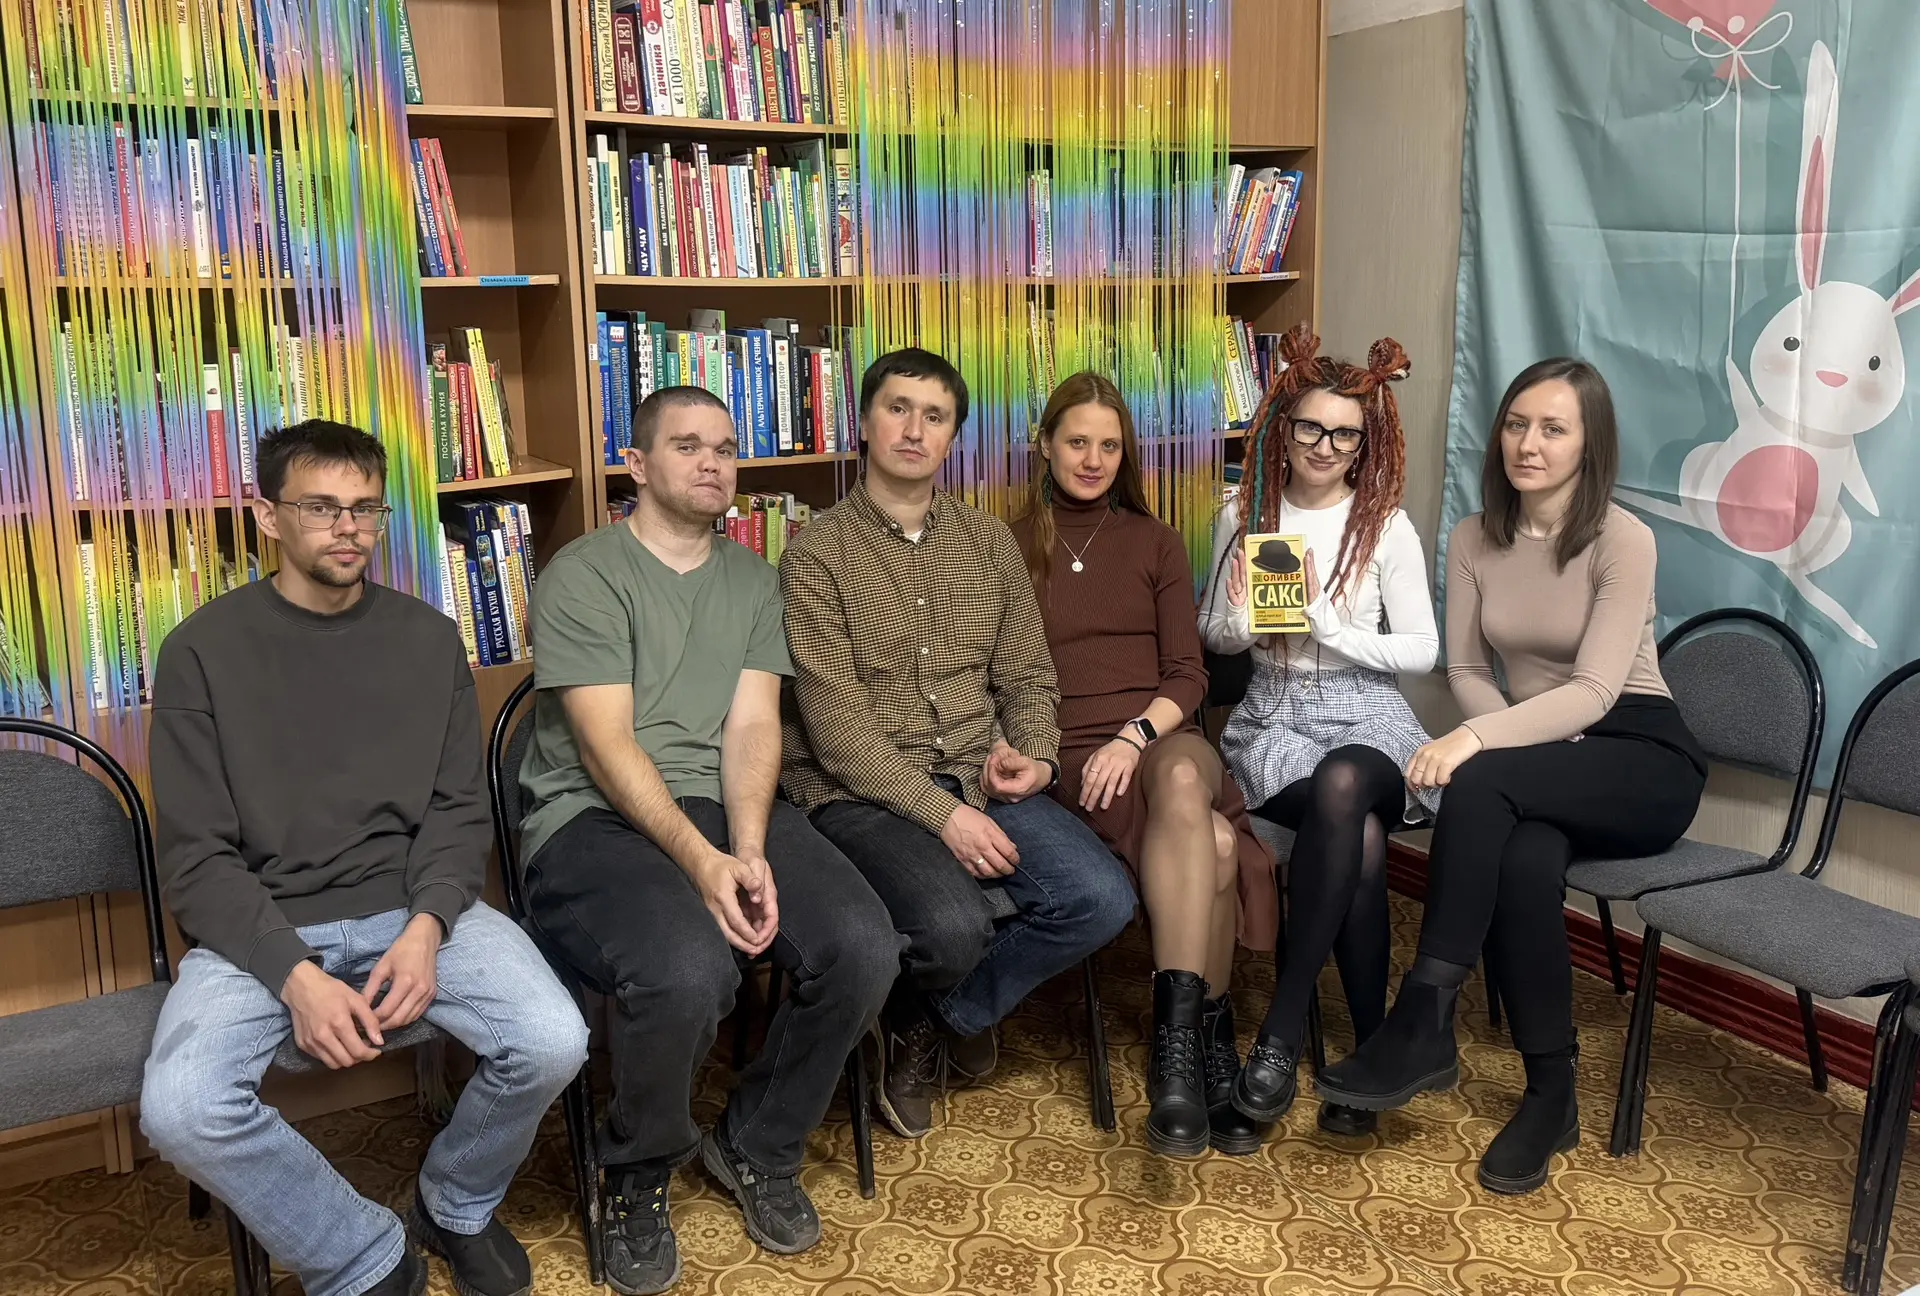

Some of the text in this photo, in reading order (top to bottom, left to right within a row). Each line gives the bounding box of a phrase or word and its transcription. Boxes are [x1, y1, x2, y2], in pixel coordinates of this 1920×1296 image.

[763, 47, 773, 72] САДУ
[807, 27, 816, 62] РАСТЕНИЯХ
[652, 44, 668, 97] дачника
[669, 59, 683, 89] 1000
[767, 87, 779, 118] ЦВЕТЫ
[700, 153, 709, 181] собакой
[277, 186, 286, 222] ДОМАШНЕГО
[417, 161, 430, 200] PHOTOSHOP
[425, 203, 438, 239] EXTENDED
[658, 181, 667, 230] ТЕЛОХРАНИТЕЛЬ
[704, 190, 713, 210] ухода
[638, 227, 649, 272] ЧАУ-ЧАУ
[706, 211, 717, 259] Энциклопедия
[655, 334, 663, 367] ЗДОРОВЬЯ
[610, 347, 622, 408] МЕДИЦИНСКИЙ
[753, 336, 765, 428] АЛЬТЕРНАТИВНОЕ ЛЕЧЕНИЕ
[778, 361, 786, 389] ДОКТОР
[824, 373, 833, 393] МИР
[780, 390, 788, 433] ДОМАШНИЙ
[825, 393, 834, 432] ПОЗНАЮ
[1240, 393, 1248, 409] ВАШЕ
[438, 391, 449, 459] ПОСТНАЯ КУХНЯ
[242, 440, 253, 482] ЗОЛОТАЯ
[440, 556, 450, 601] УГОЩЕНИЯ
[1254, 583, 1303, 607] САКС
[1263, 573, 1301, 582] ОЛИВЕР
[487, 589, 506, 648] РУССКАЯ КУХНЯ
